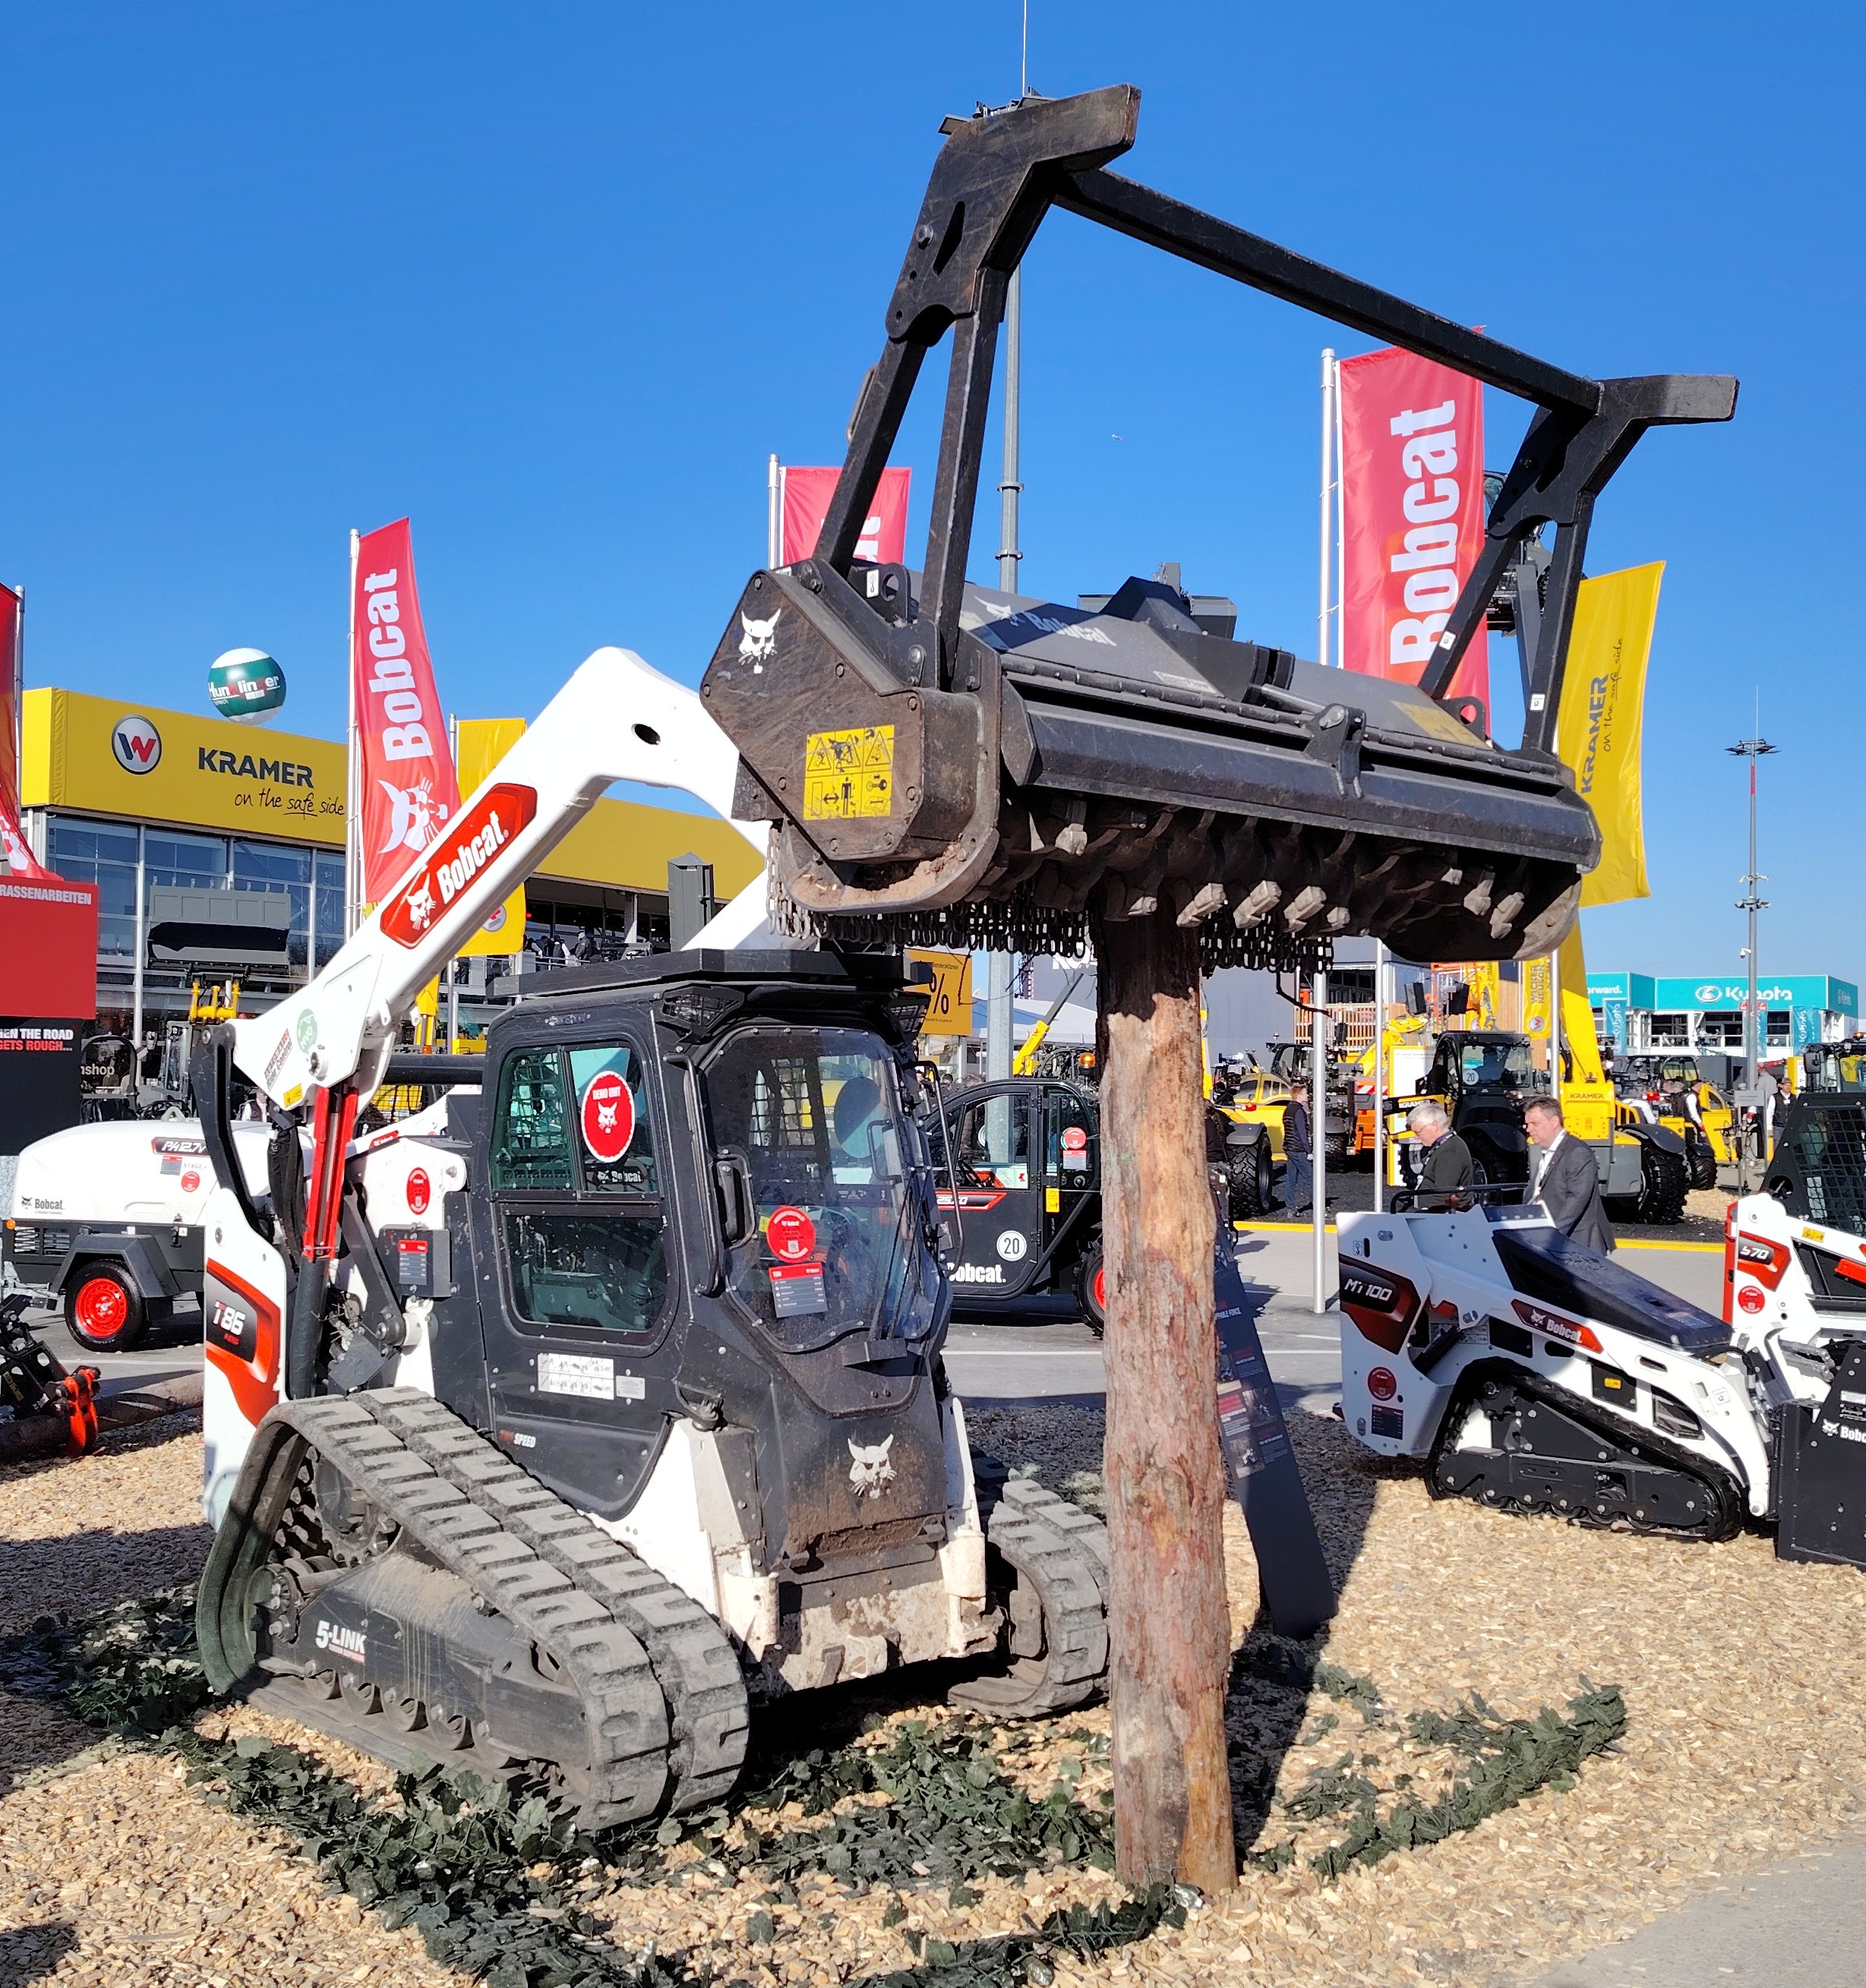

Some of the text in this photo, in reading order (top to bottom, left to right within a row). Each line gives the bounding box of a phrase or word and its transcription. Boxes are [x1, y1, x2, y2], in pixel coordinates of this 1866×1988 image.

[1390, 399, 1459, 664] Bobcat
[364, 568, 434, 761] Bobcat
[1603, 636, 1623, 752] on the safe side
[1580, 673, 1609, 794] KRAMER
[198, 746, 314, 789] KRAMER
[235, 788, 346, 820] on the safe side
[436, 810, 506, 904] Bobcat
[0, 884, 92, 905] RASSENARBEITEN
[20, 1028, 40, 1040] THE
[43, 1029, 74, 1040] ROAD
[1467, 1073, 1475, 1082] 20
[592, 1088, 608, 1100] DEMO
[35, 1198, 63, 1210] Bobcat
[1003, 1237, 1020, 1254] 20
[1740, 1245, 1770, 1260] S70
[213, 1301, 246, 1335] T86
[1546, 1319, 1582, 1343] Bobcat
[513, 1433, 536, 1448] SPEED
